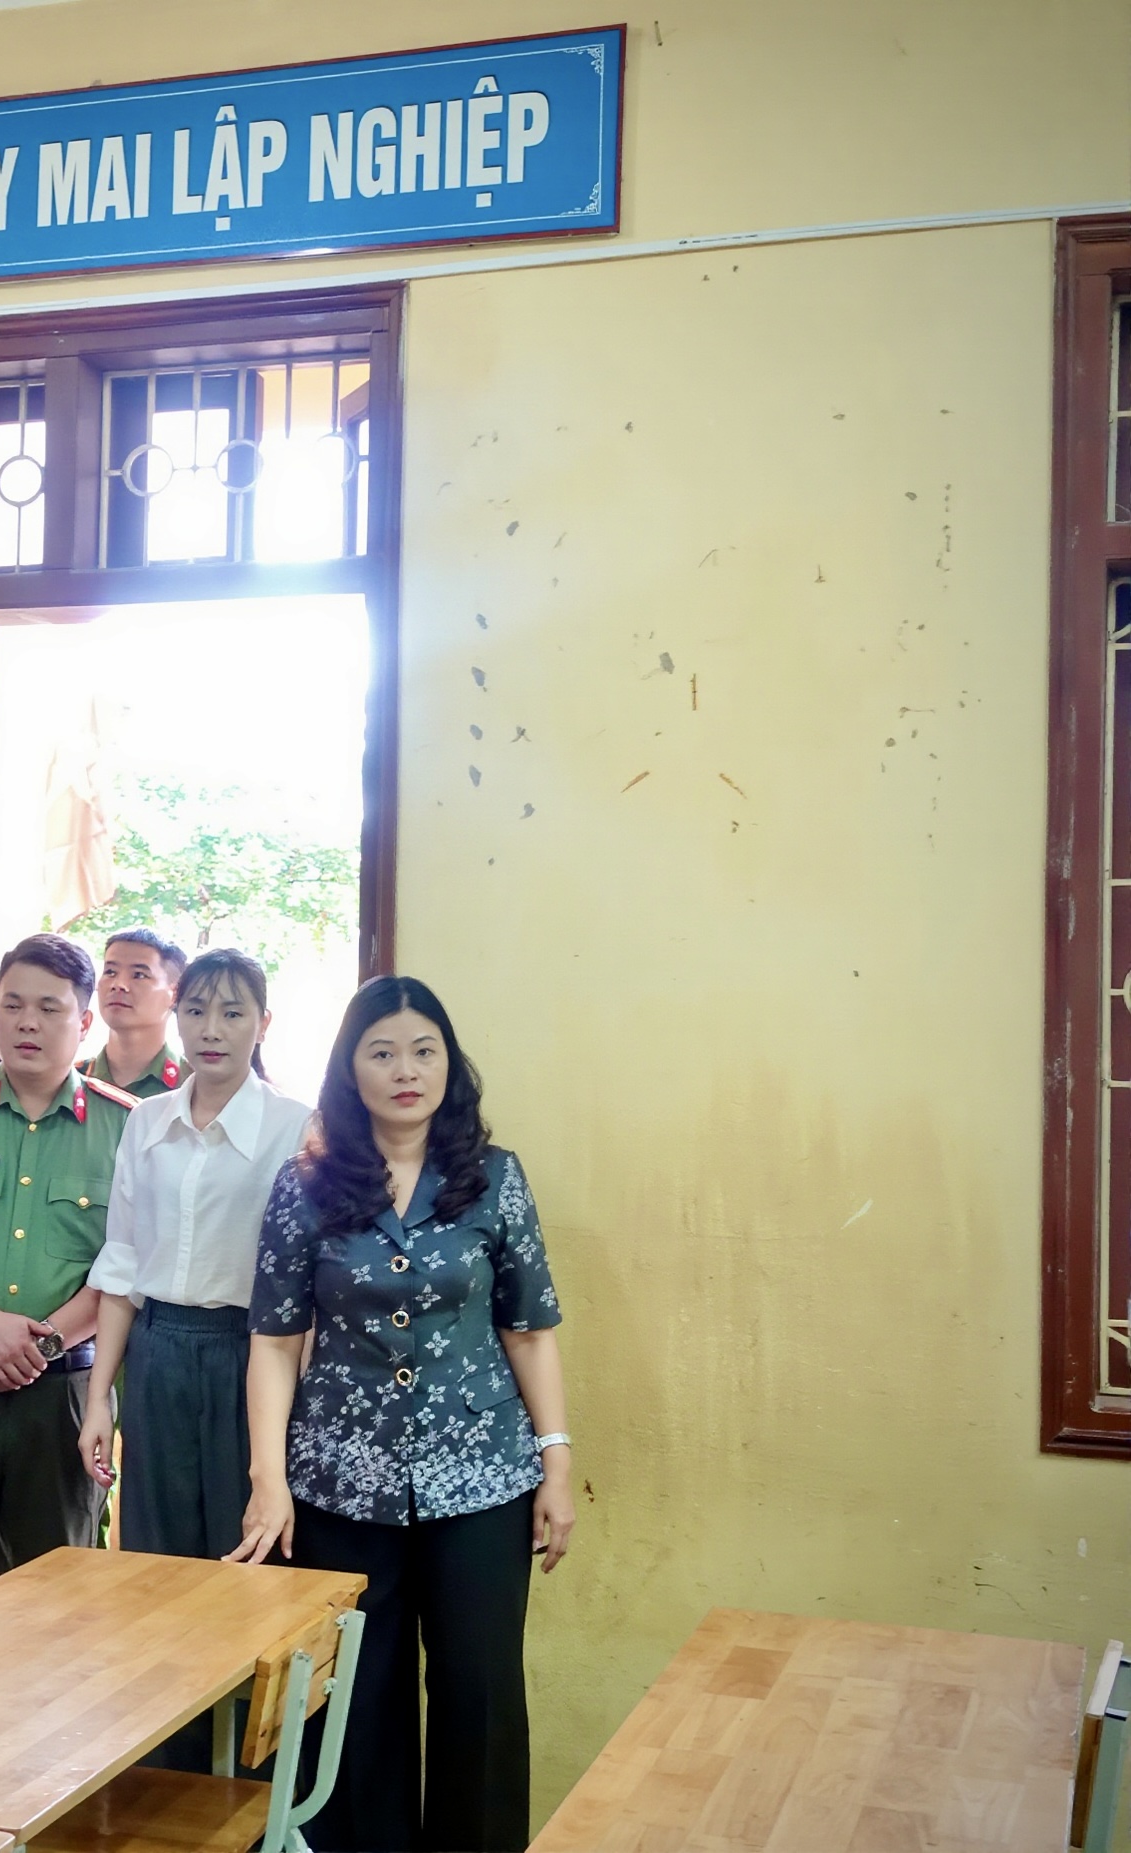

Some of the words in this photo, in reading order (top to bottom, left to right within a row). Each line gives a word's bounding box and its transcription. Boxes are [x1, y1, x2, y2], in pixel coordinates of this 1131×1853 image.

[37, 136, 152, 227] MAI
[172, 105, 287, 232] LẬP
[308, 76, 549, 208] NGHIỆP
